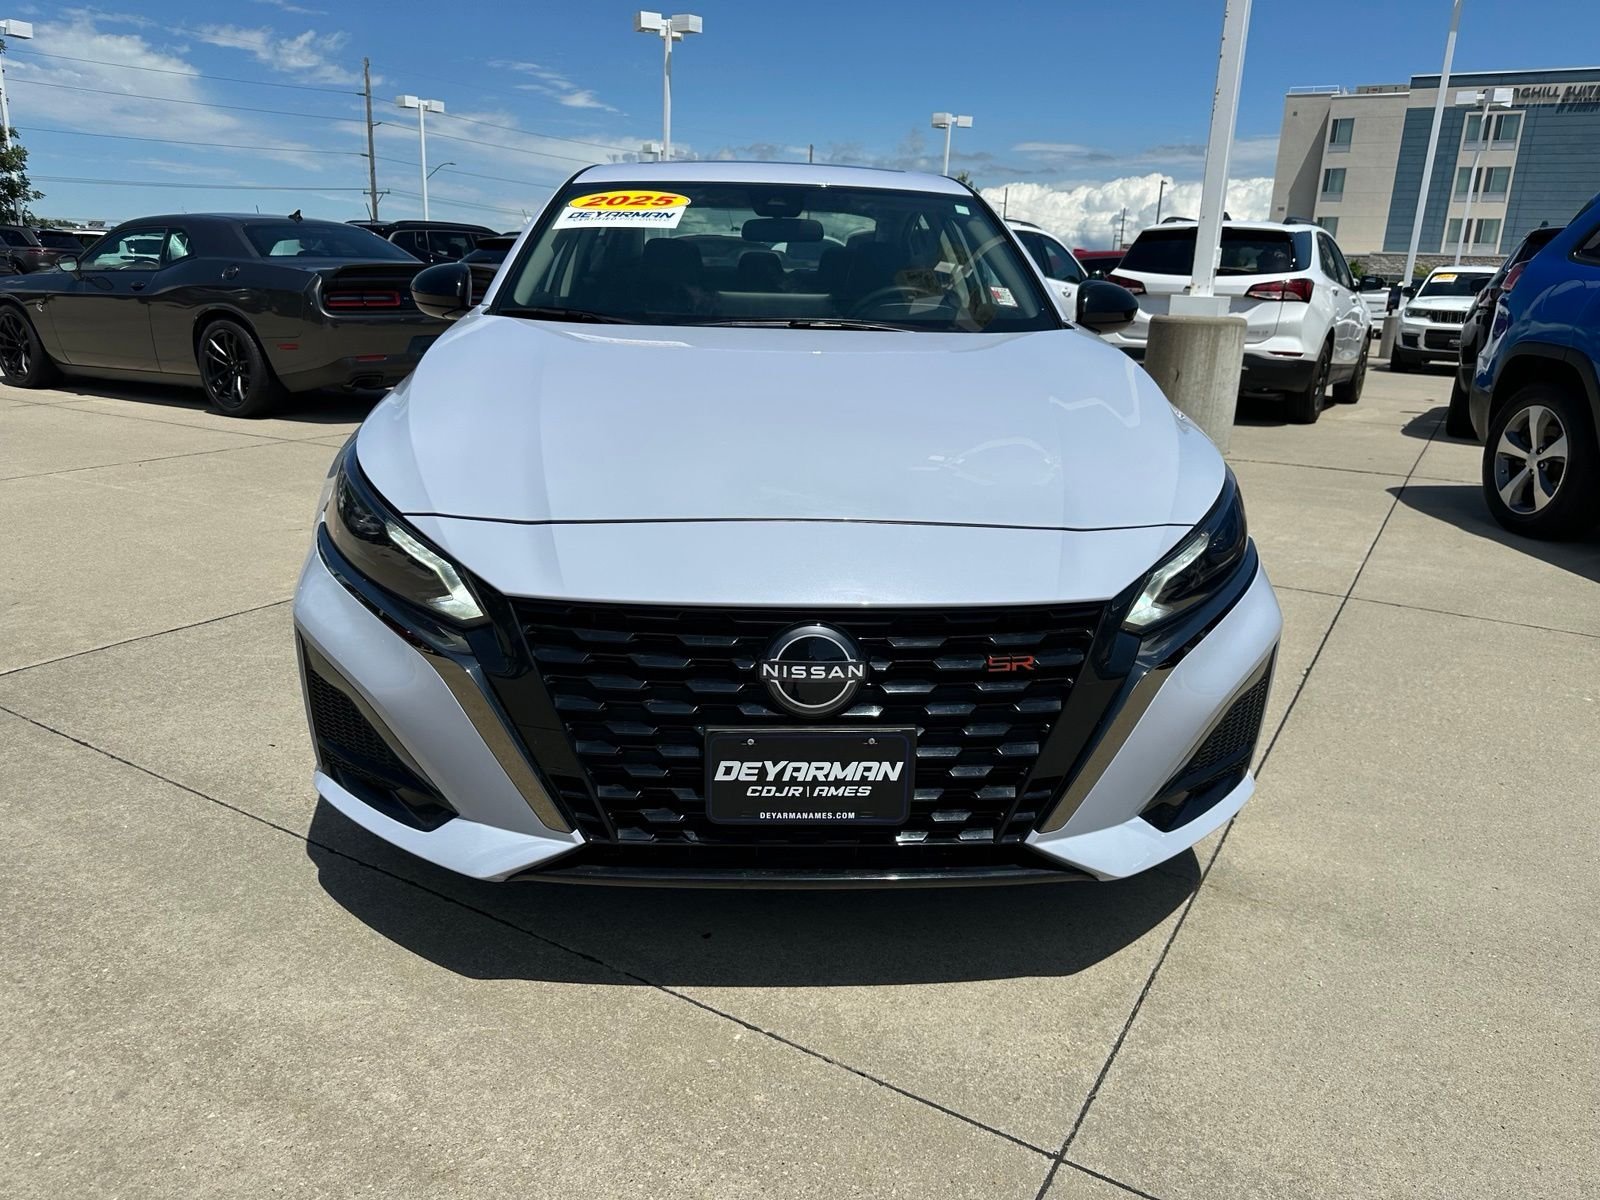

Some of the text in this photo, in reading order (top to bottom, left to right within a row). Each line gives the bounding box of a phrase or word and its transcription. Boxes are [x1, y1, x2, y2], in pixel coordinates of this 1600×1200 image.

[581, 196, 677, 207] 2025
[568, 211, 675, 219] DEYARMAN
[988, 656, 1034, 672] SR
[763, 663, 863, 679] NISSAN
[714, 760, 904, 782] DEYARMAN
[746, 786, 804, 797] CDJR
[813, 786, 872, 797] AMES
[759, 812, 856, 820] DEYARMANAMES.COM
